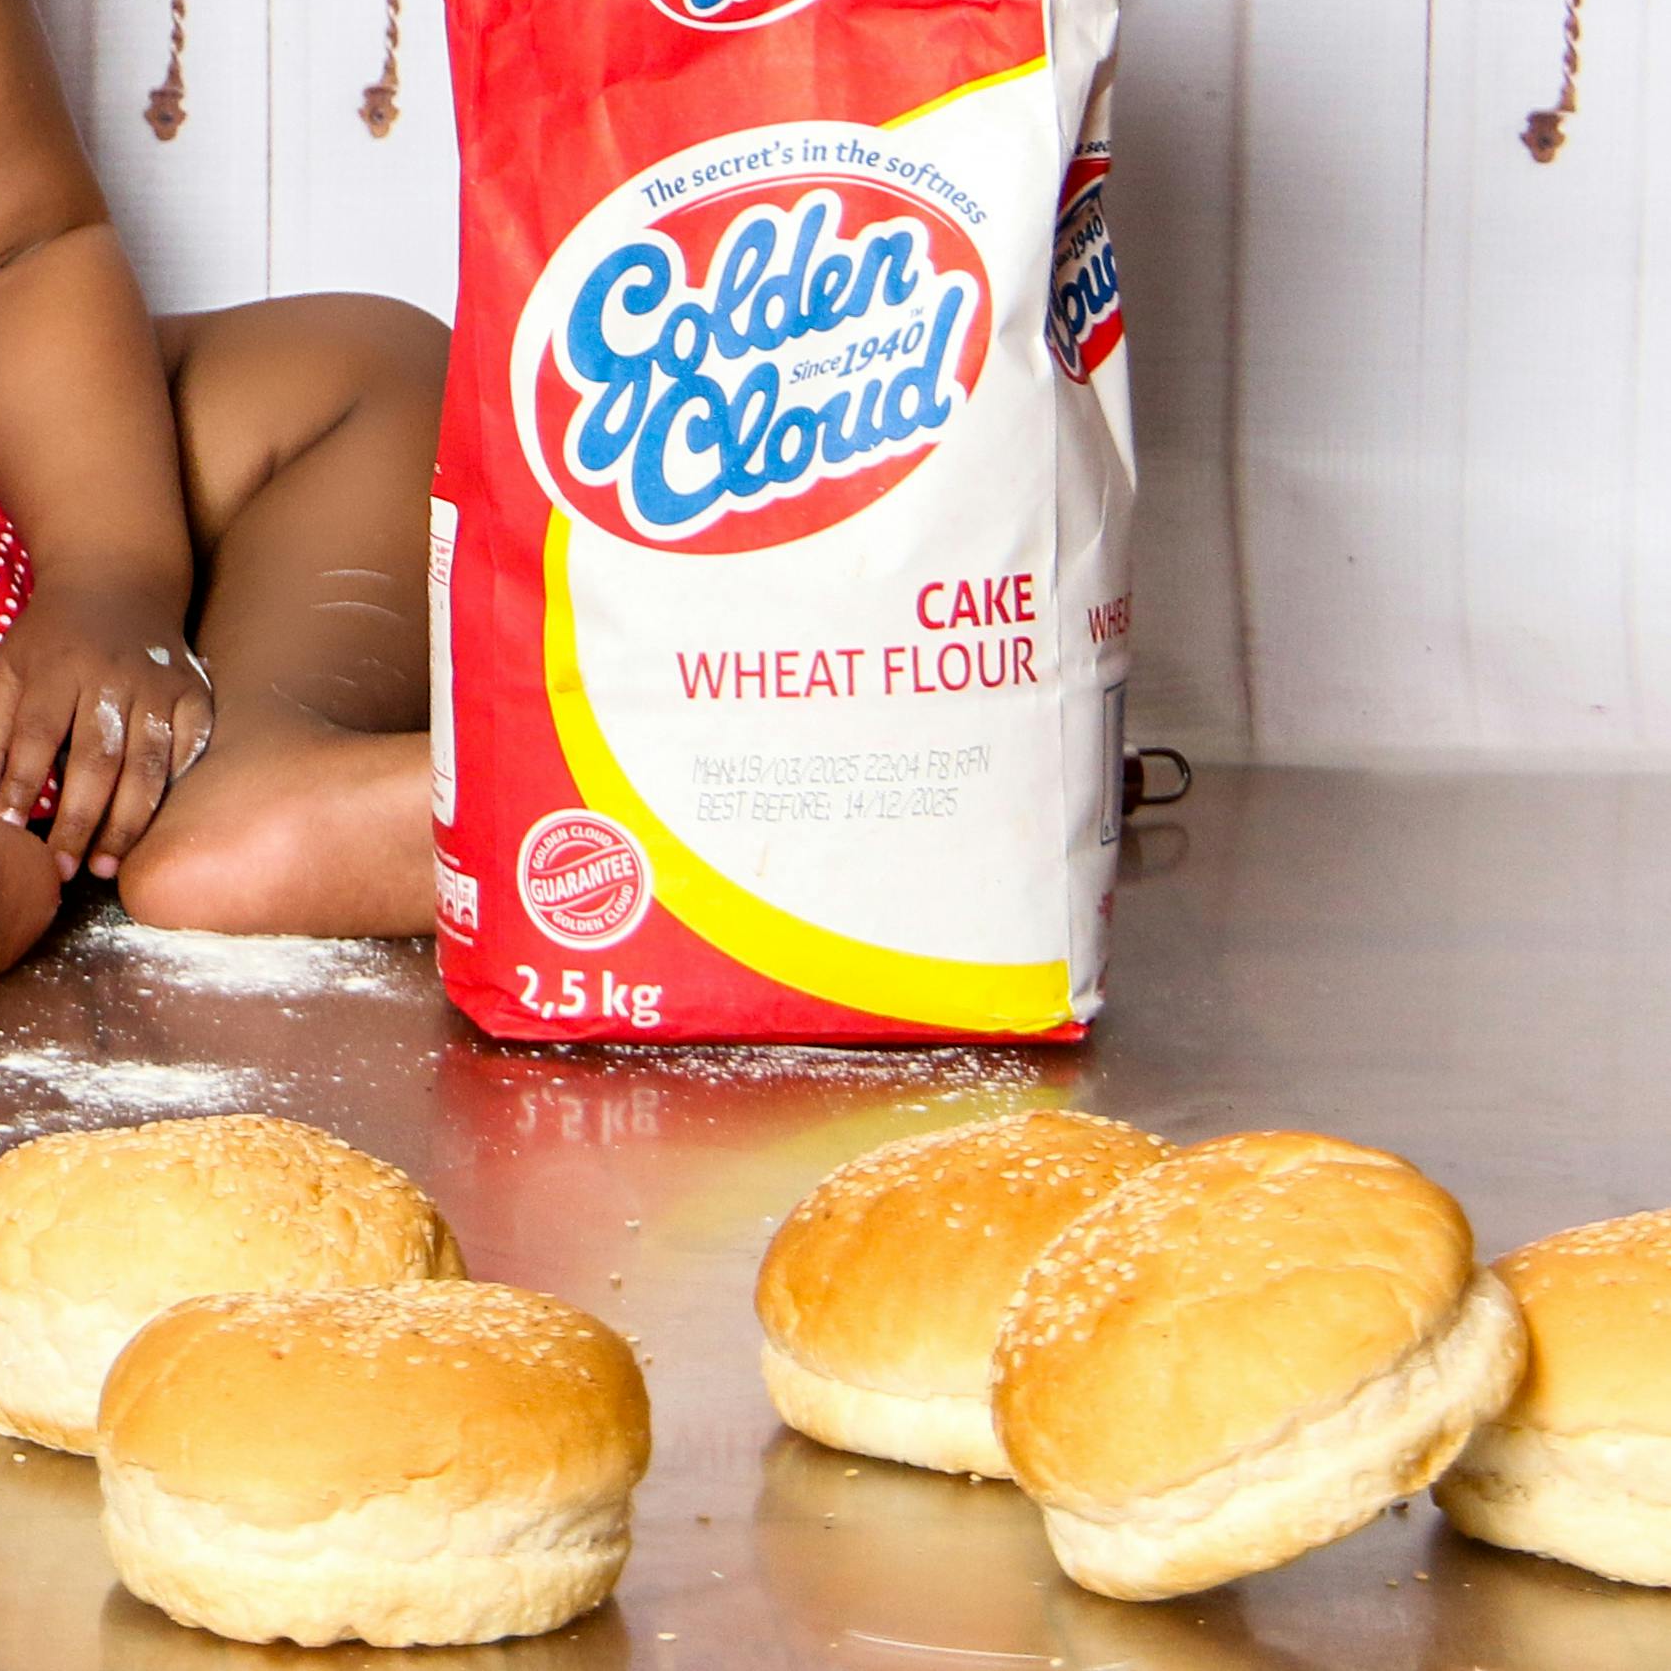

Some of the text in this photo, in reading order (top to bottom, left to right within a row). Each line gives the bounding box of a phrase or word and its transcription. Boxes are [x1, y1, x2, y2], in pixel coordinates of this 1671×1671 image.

[640, 138, 988, 227] The secret's in the softness
[567, 202, 919, 471] Golden
[789, 320, 925, 386] Since 1940
[632, 286, 964, 526] Cloud
[916, 573, 1036, 630] CAKE
[676, 636, 1038, 699] WHEAT FLOUR
[697, 790, 748, 822] BEST
[530, 852, 635, 904] GUARANTEE
[531, 825, 614, 871] GOLDEN CLOUD
[551, 884, 635, 933] GOLDEN CLOUD
[515, 964, 663, 1028] 2,5 kg
